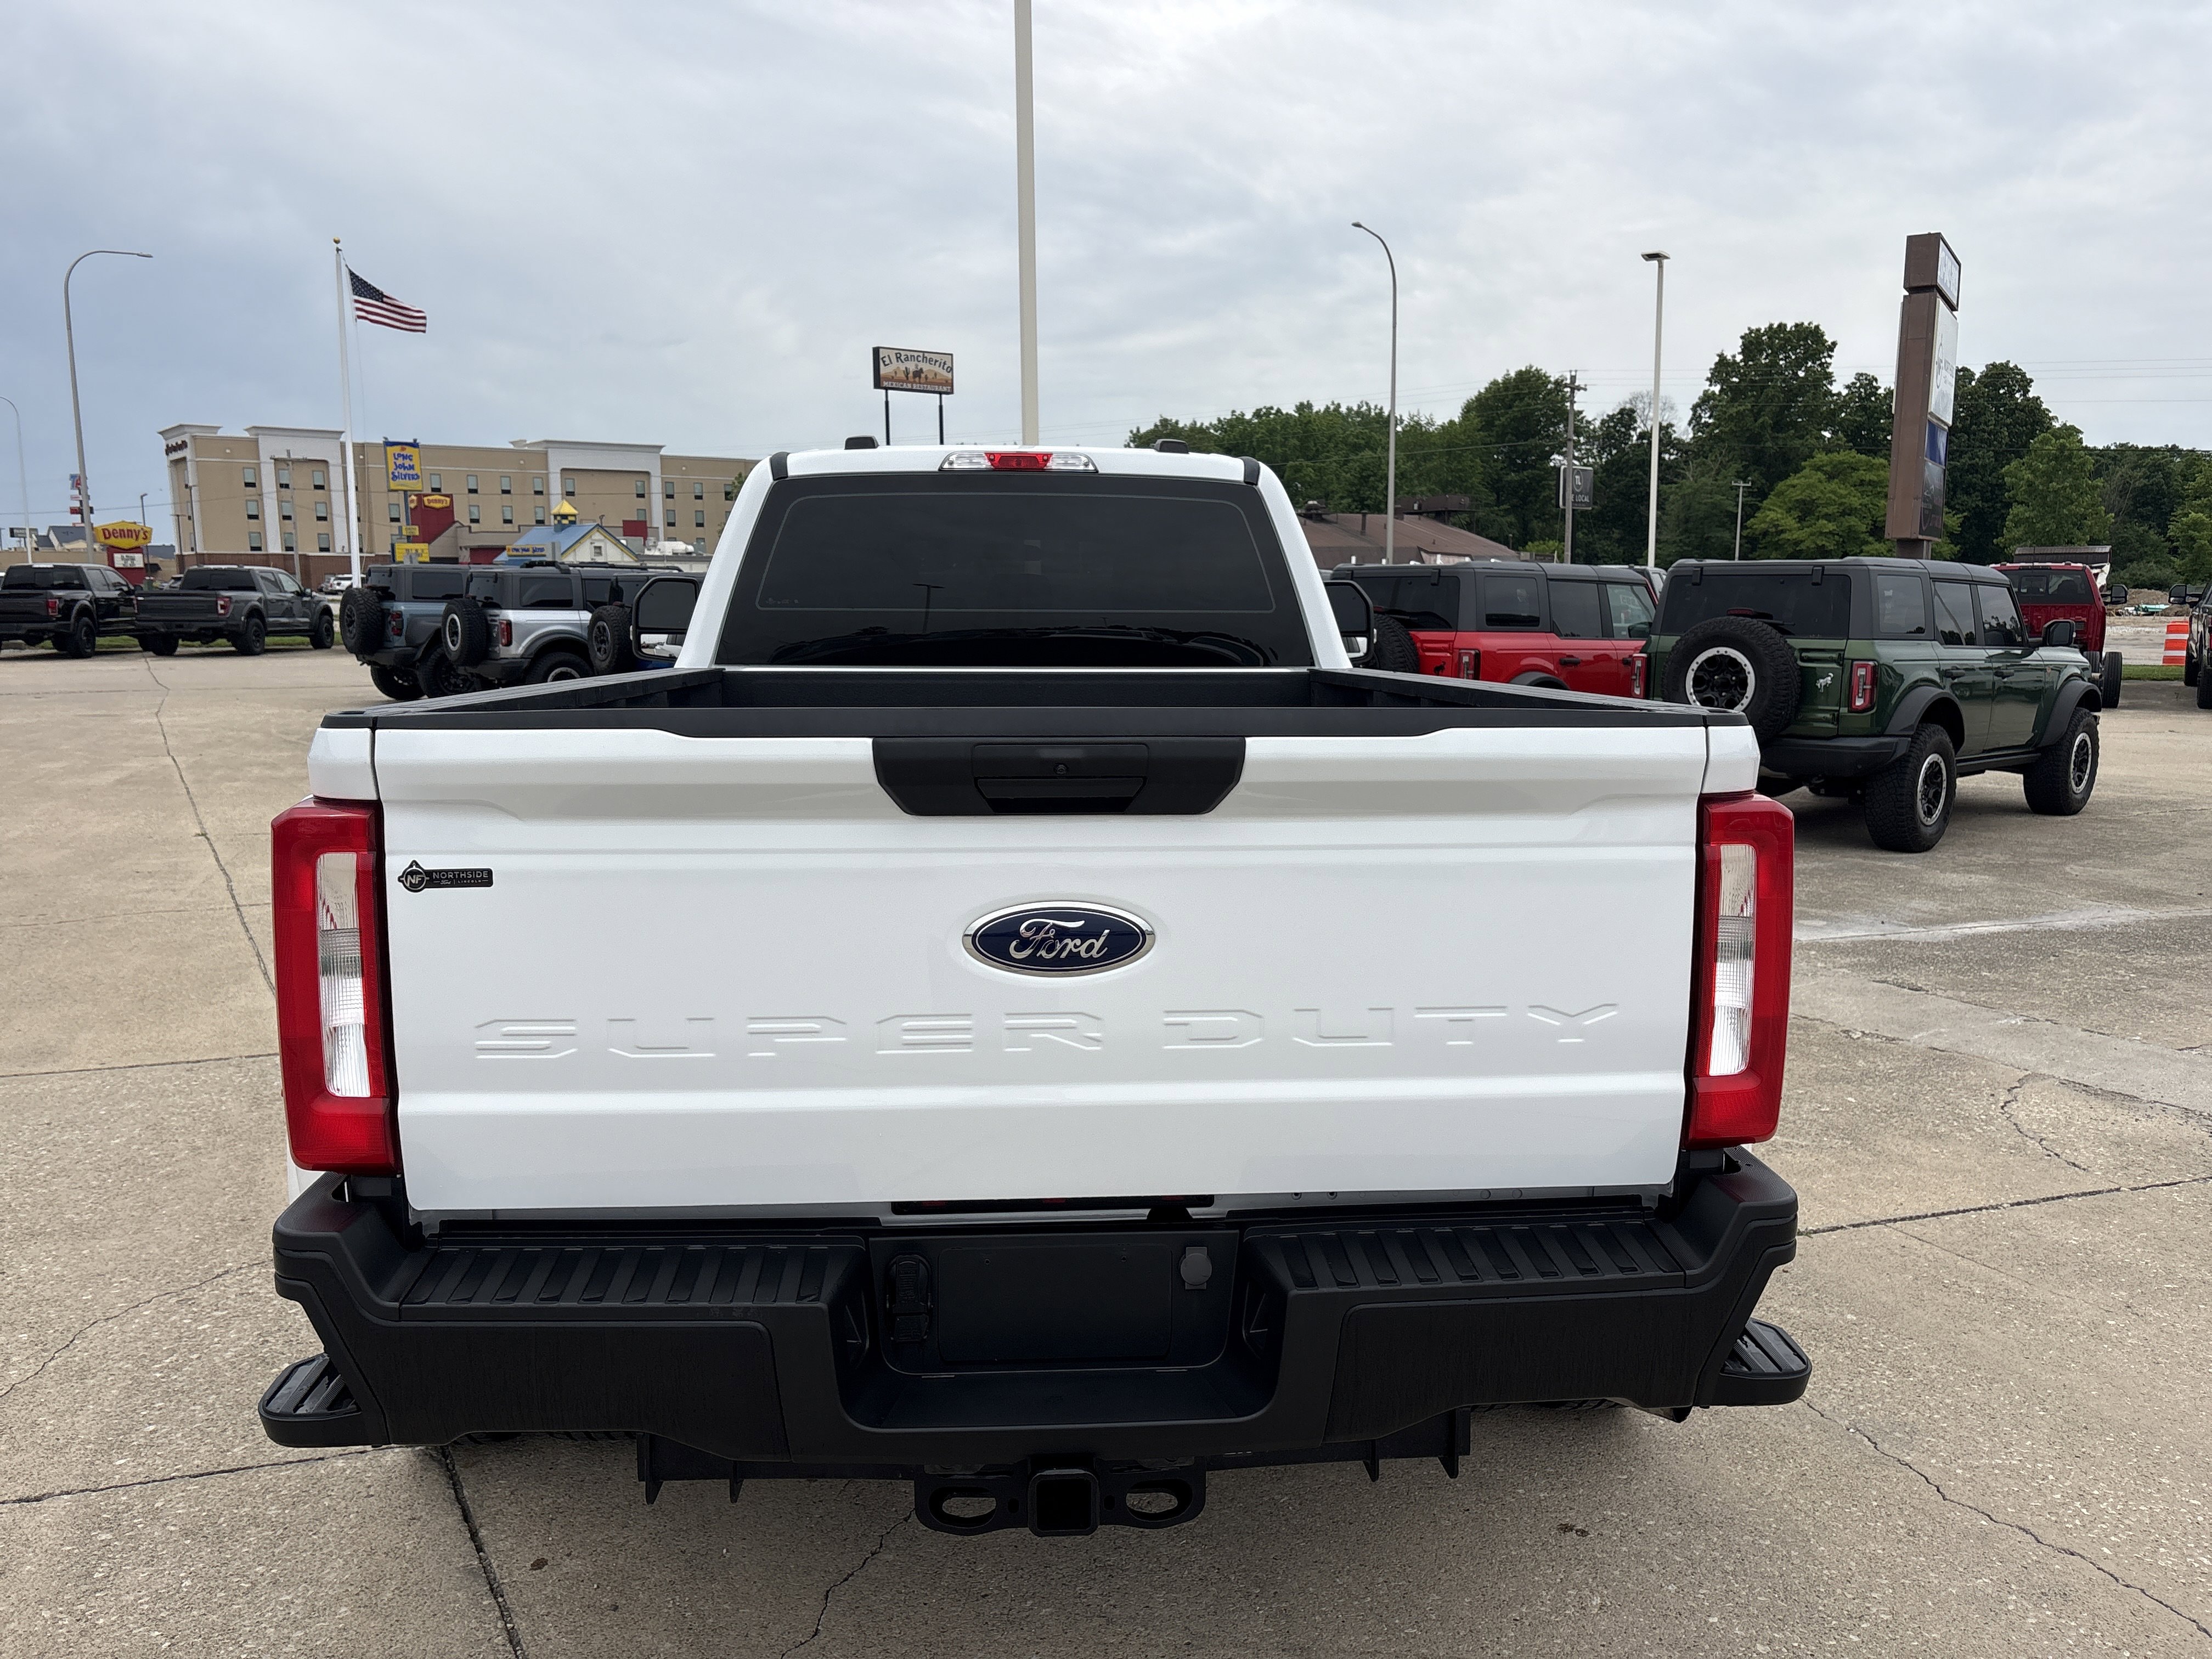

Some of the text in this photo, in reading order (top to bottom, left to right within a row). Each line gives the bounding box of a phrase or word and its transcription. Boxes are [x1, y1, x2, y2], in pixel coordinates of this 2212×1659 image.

[881, 352, 952, 374] El Rancherito
[913, 383, 951, 392] RESTAURANT
[1575, 494, 1589, 503] LOCAL
[101, 527, 148, 541] Denny's
[432, 871, 489, 879] NORTHSIDE
[1009, 918, 1110, 959] Ford
[475, 1003, 1618, 1059] SUPER DUTY
